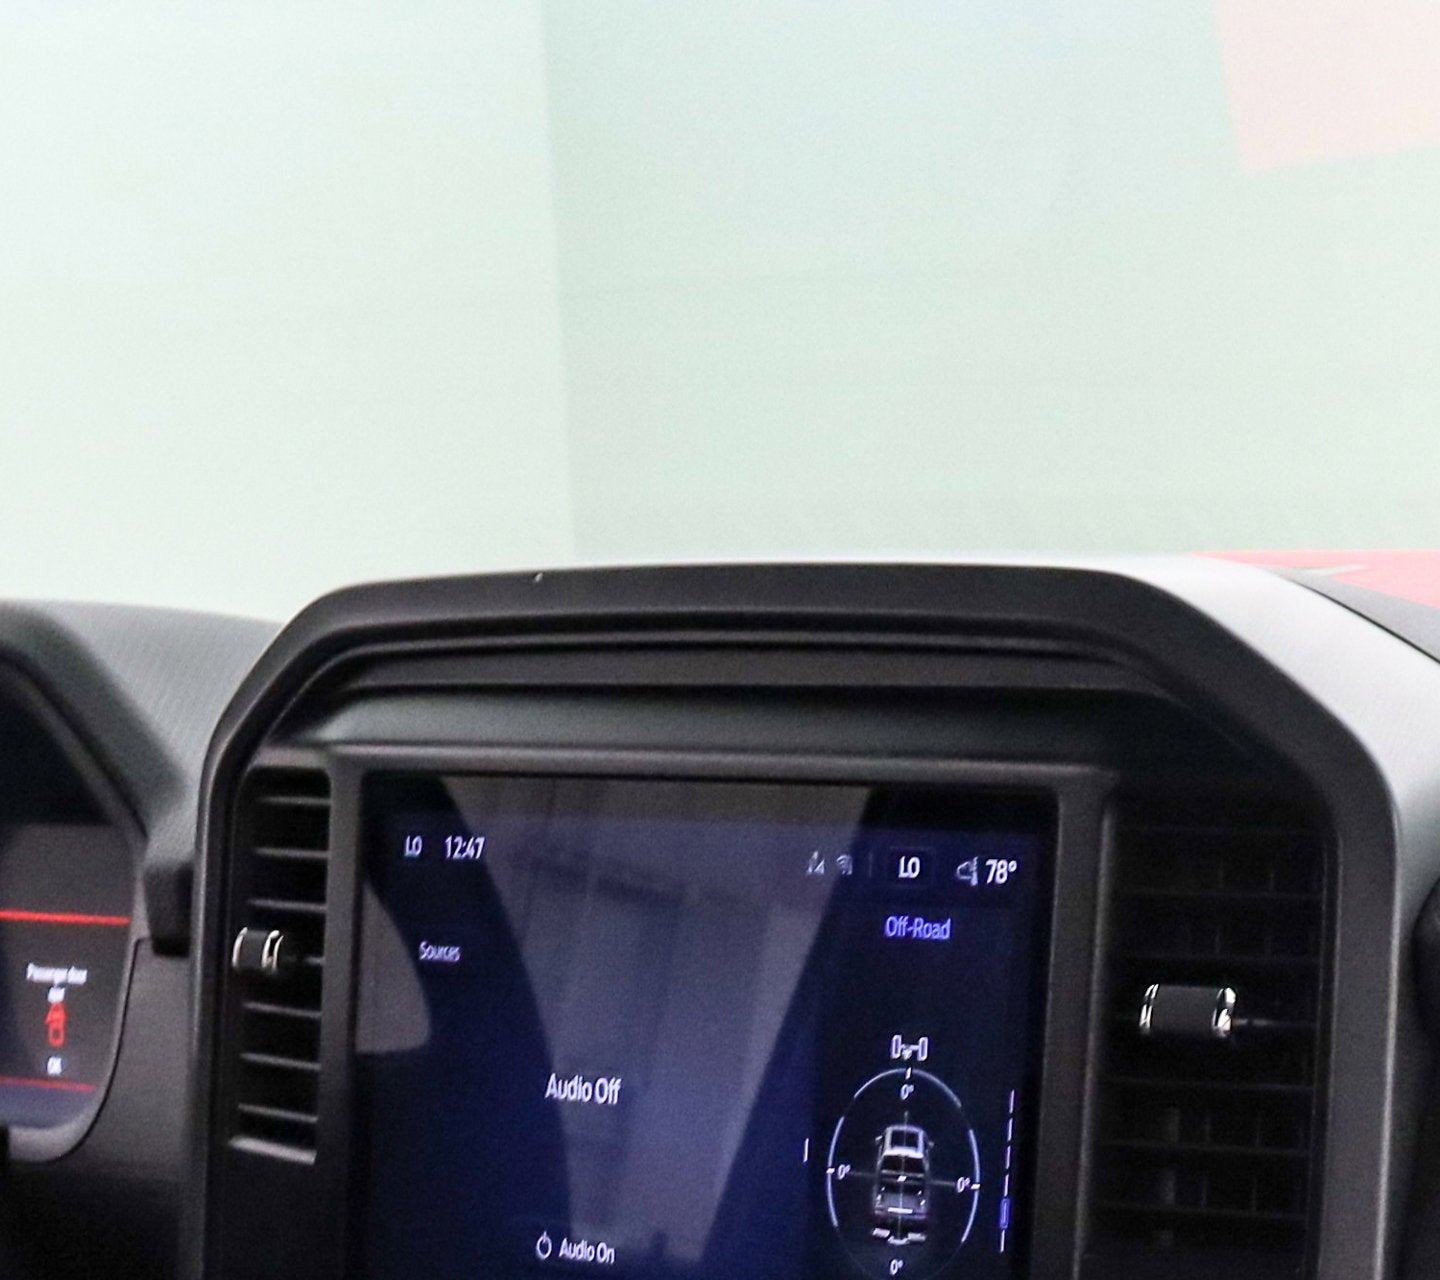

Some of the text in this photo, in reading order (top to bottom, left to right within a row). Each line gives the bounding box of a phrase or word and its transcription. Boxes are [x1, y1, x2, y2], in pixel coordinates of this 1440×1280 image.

[404, 835, 423, 857] LO
[445, 835, 486, 860] 12:47
[898, 856, 921, 878] LO
[985, 859, 1018, 884] 78°
[885, 916, 951, 940] Off-Road
[420, 941, 461, 962] Sources
[545, 1073, 622, 1105] Audio Off
[559, 1238, 615, 1265] Audio On
